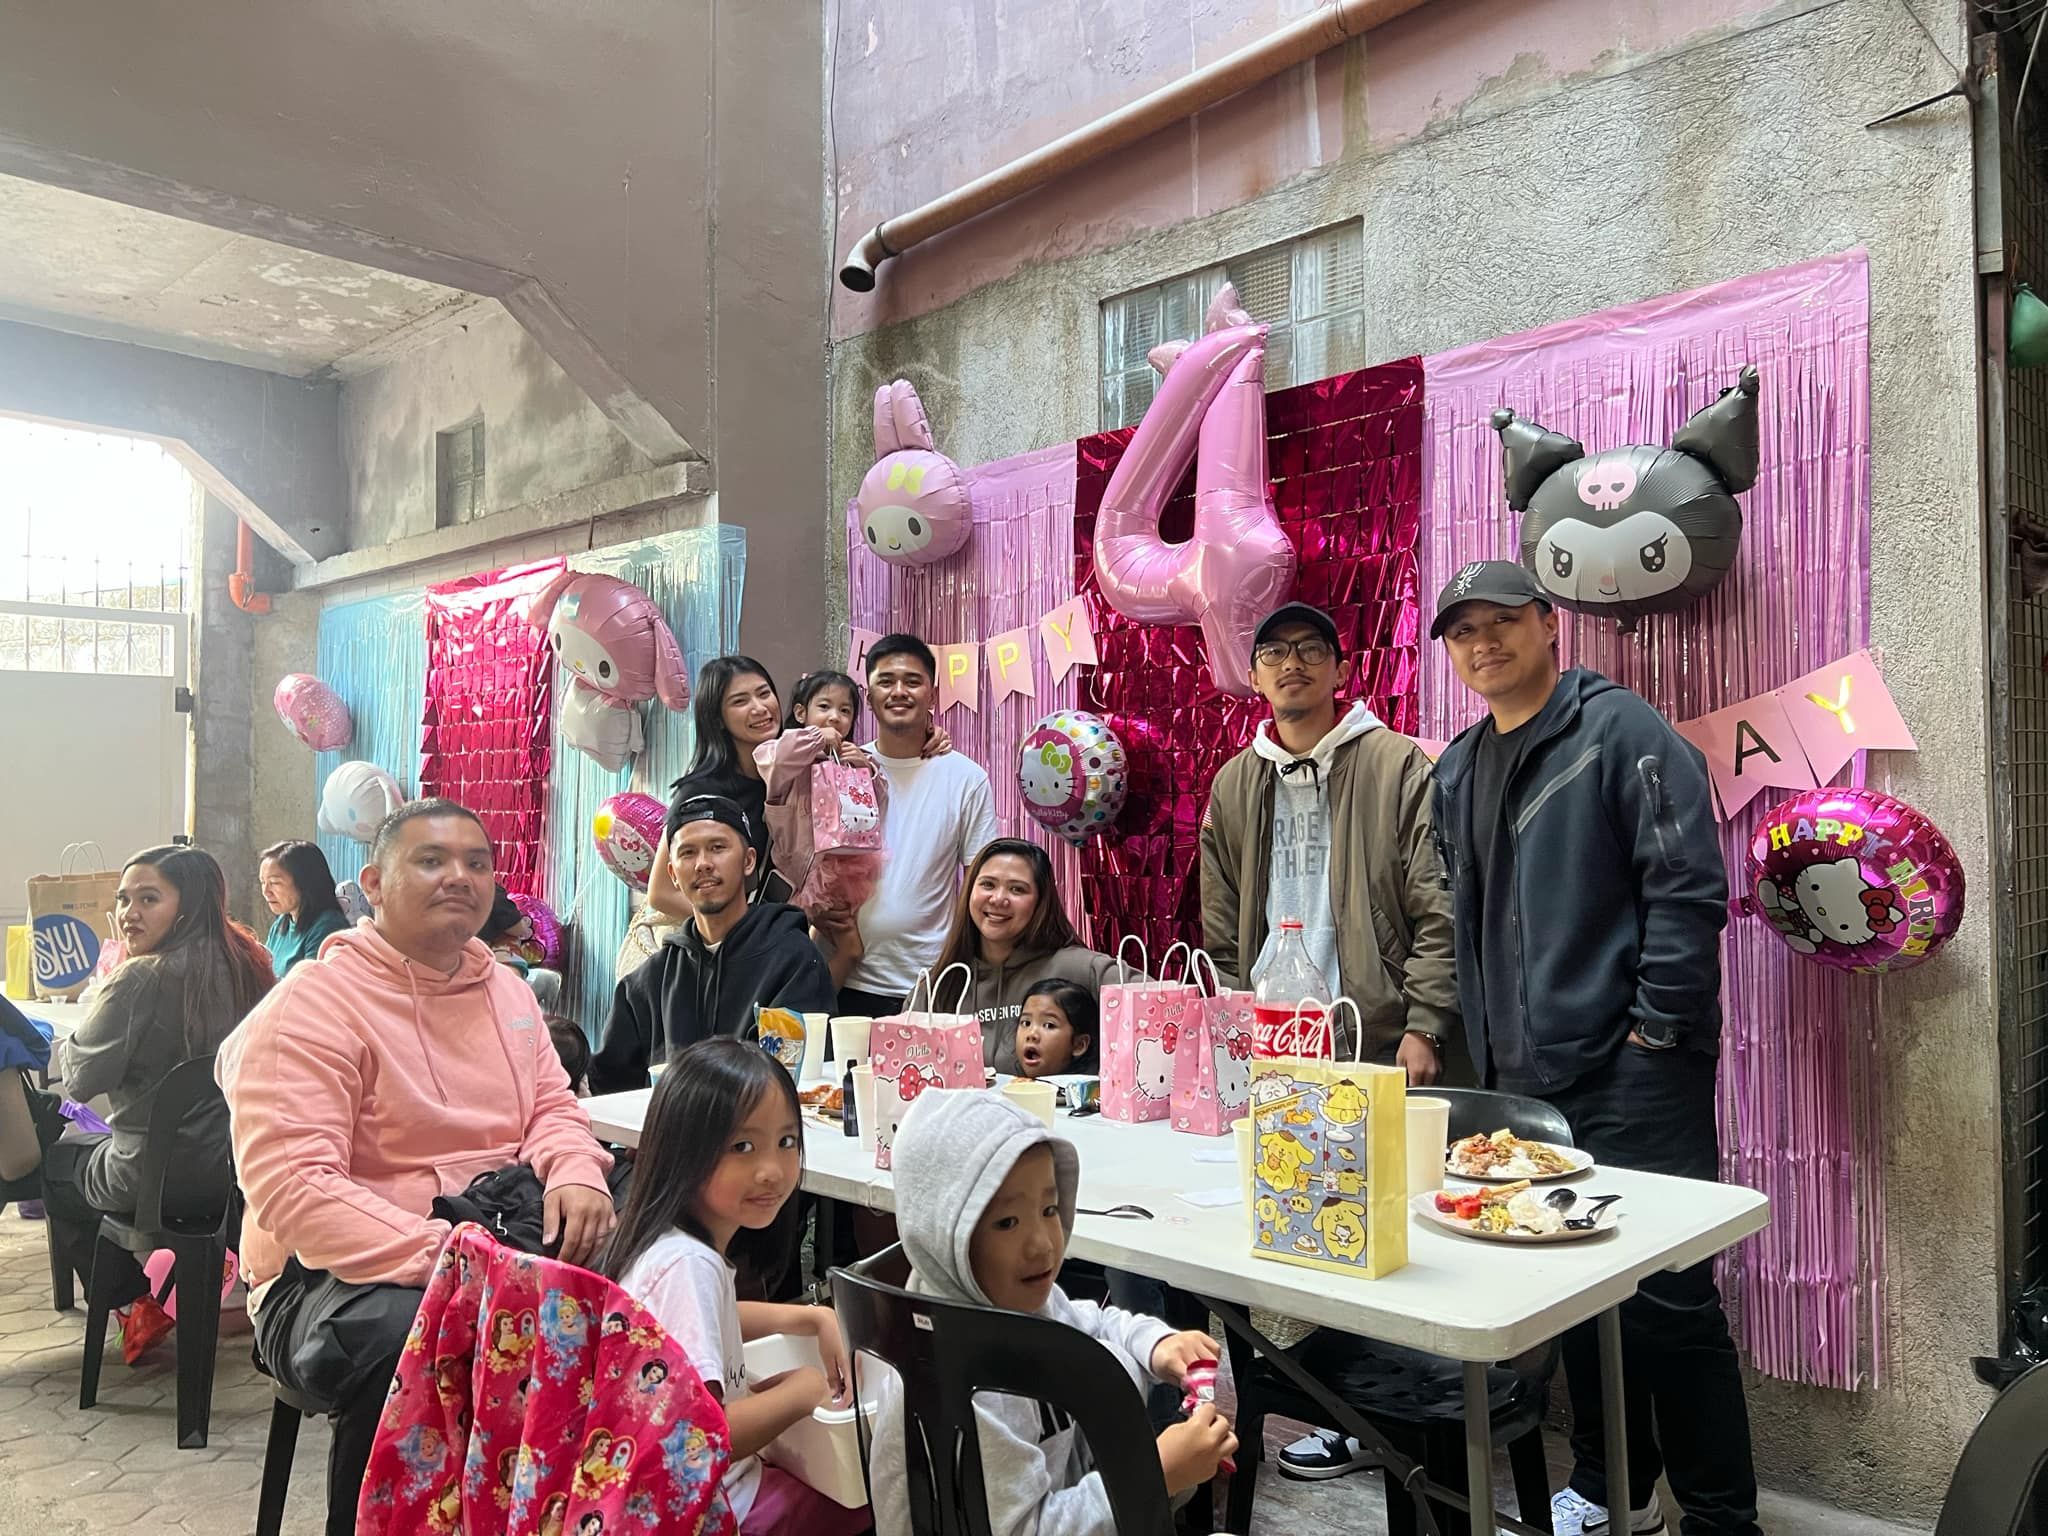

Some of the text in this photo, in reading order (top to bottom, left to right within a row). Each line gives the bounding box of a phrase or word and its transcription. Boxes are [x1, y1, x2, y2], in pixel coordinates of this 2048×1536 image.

[856, 612, 1073, 688] HPPY
[1275, 811, 1319, 847] RAGE
[1769, 818, 1893, 859] HAPPY
[32, 920, 90, 981] SM
[978, 1004, 1023, 1023] SEVEN FO
